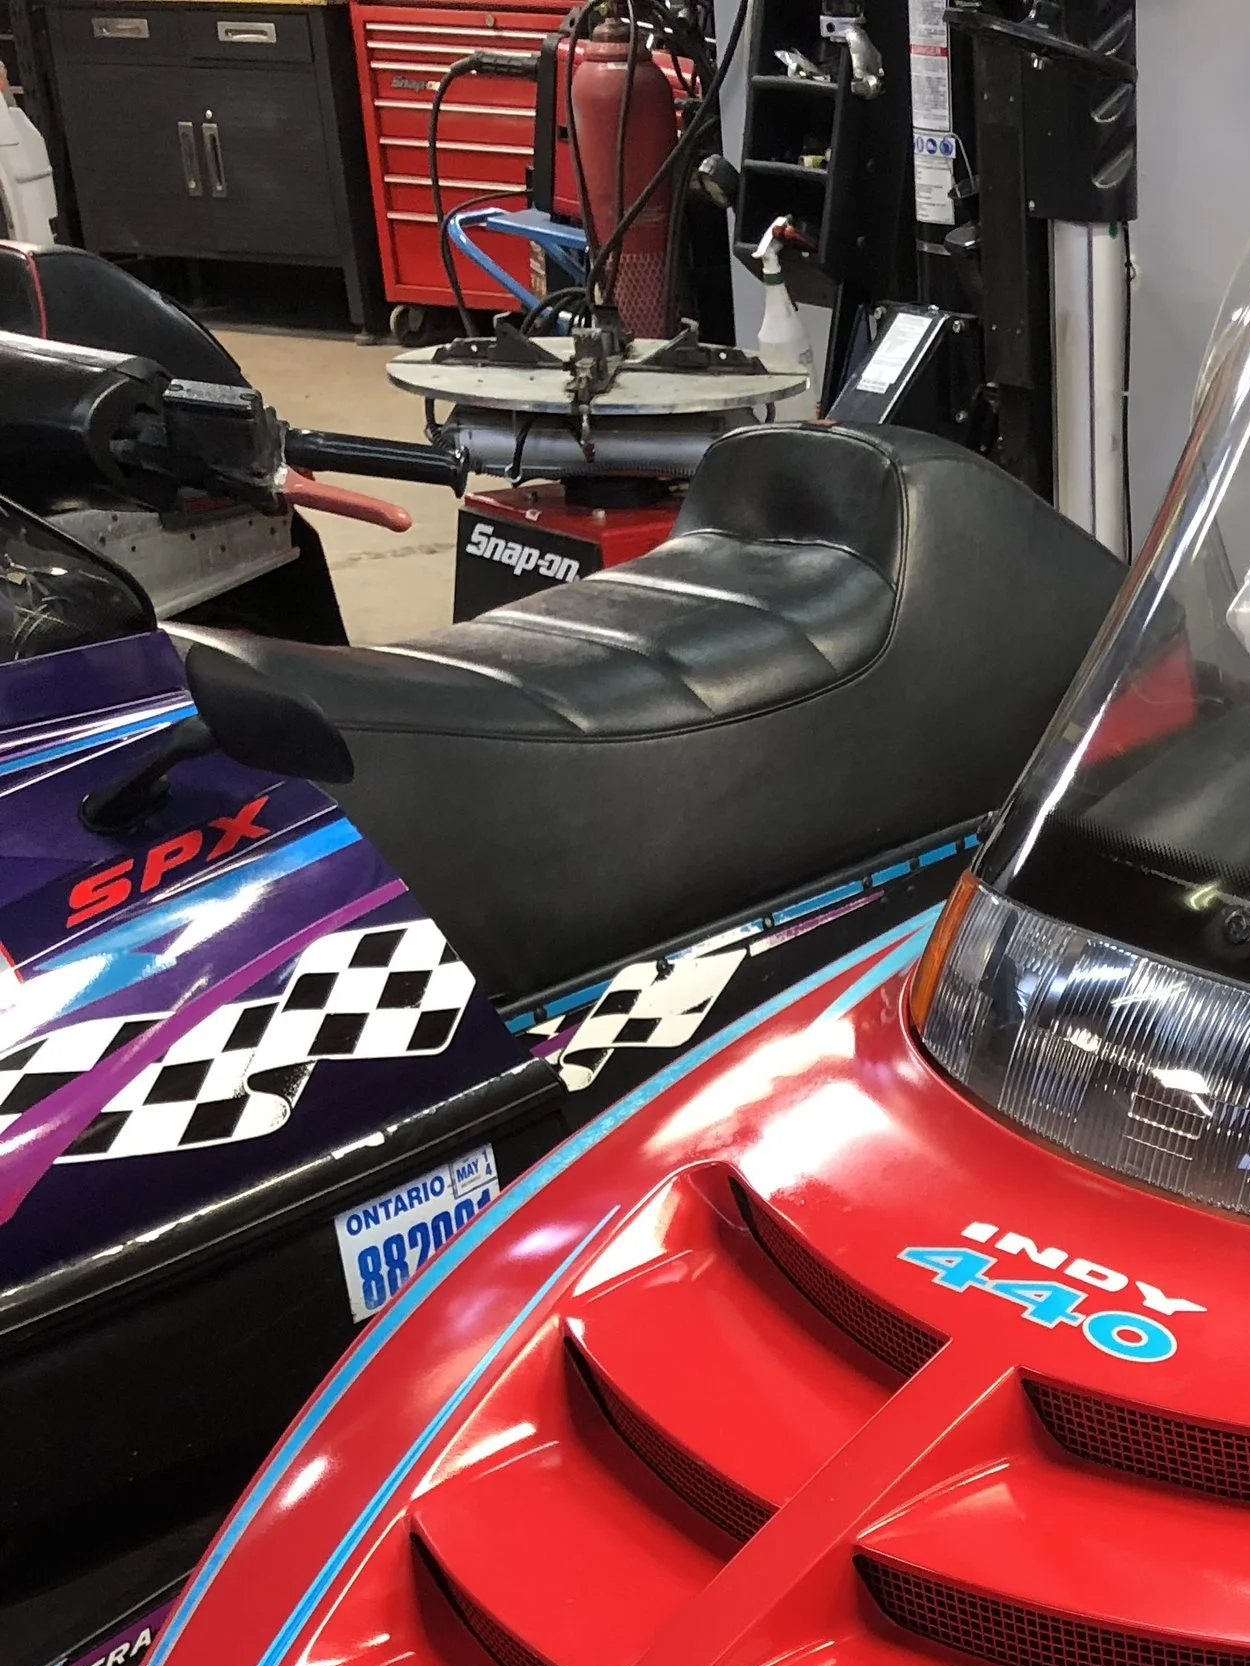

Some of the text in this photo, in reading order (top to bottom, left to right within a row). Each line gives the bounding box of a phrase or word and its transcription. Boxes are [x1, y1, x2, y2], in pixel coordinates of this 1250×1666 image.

[466, 523, 580, 583] Snap-on
[66, 796, 270, 927] SPX
[346, 1175, 445, 1236] ONTARIO
[456, 1159, 480, 1183] MAY
[896, 1246, 1178, 1363] 440
[960, 1221, 1208, 1315] INDY
